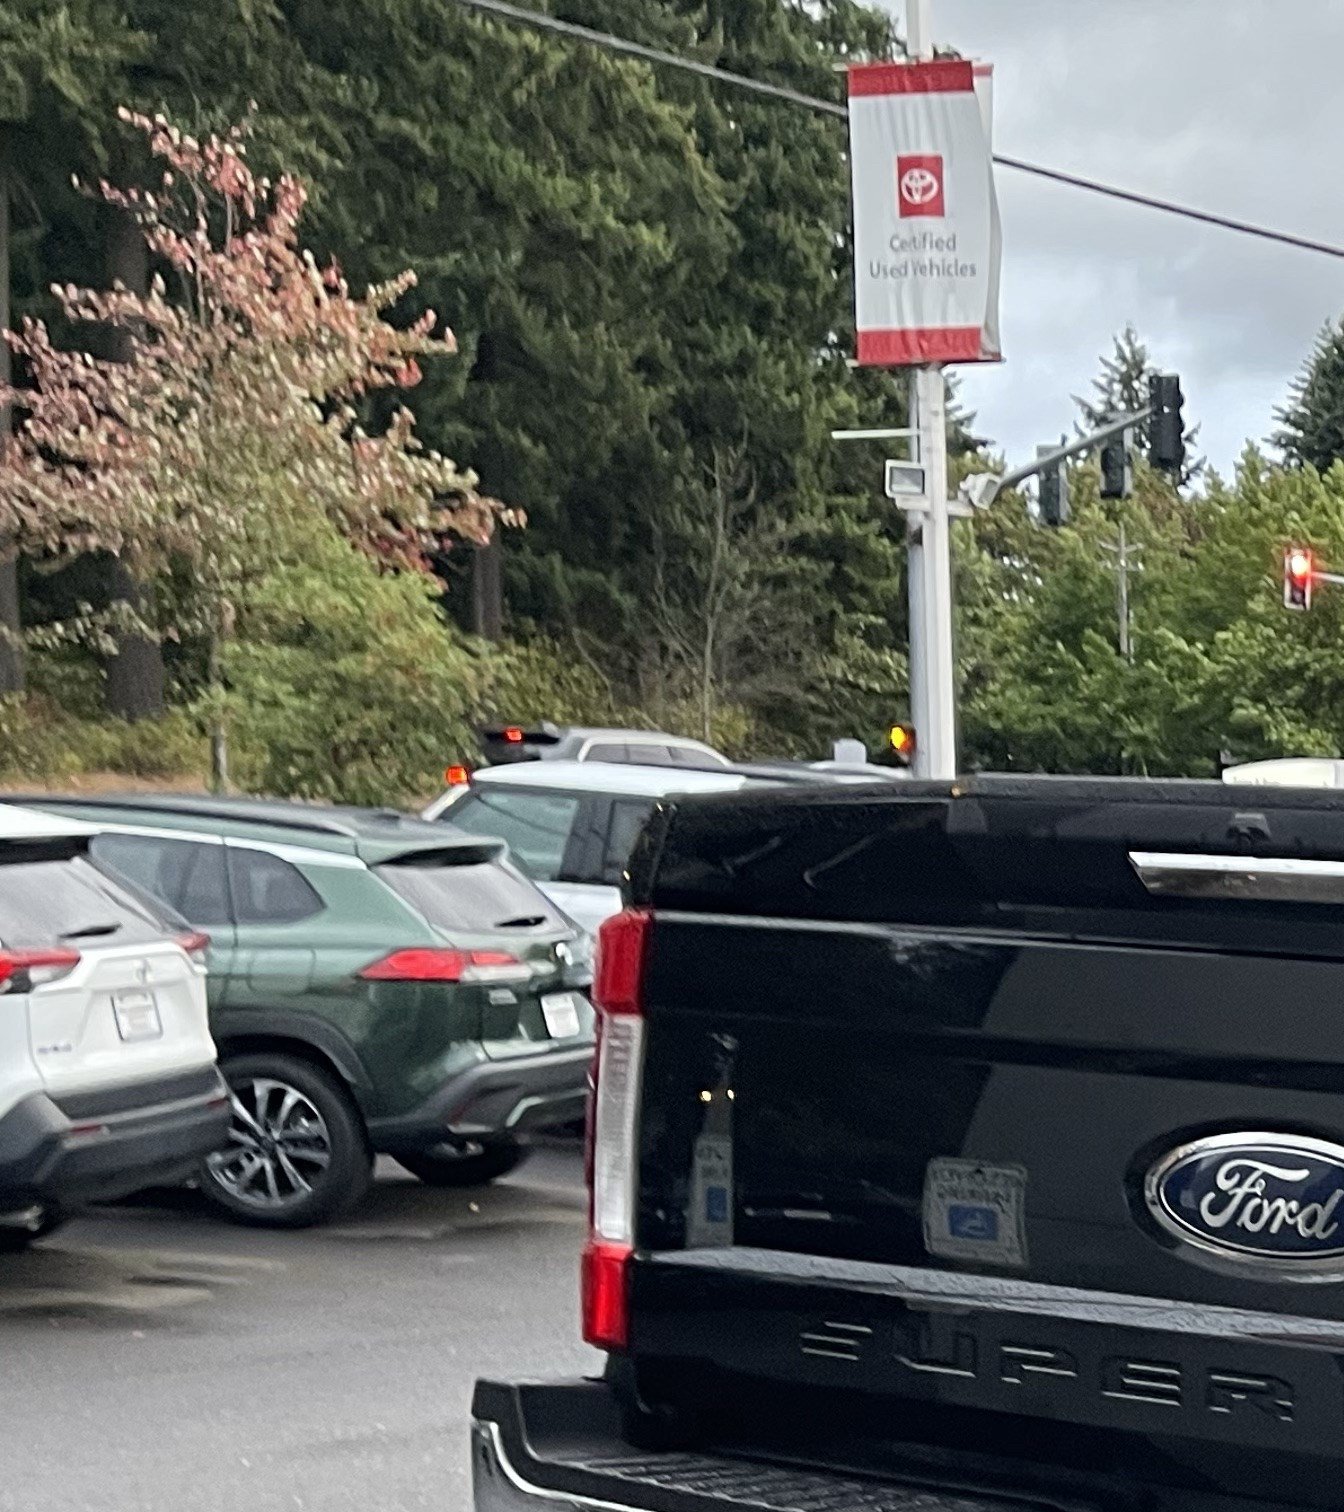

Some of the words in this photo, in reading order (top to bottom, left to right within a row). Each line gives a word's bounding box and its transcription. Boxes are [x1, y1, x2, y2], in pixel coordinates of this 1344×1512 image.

[890, 233, 956, 252] Certified
[869, 260, 908, 279] Used
[911, 260, 977, 278] Vehicles
[1200, 1158, 1344, 1239] Ford
[799, 1318, 1296, 1424] SUPER
